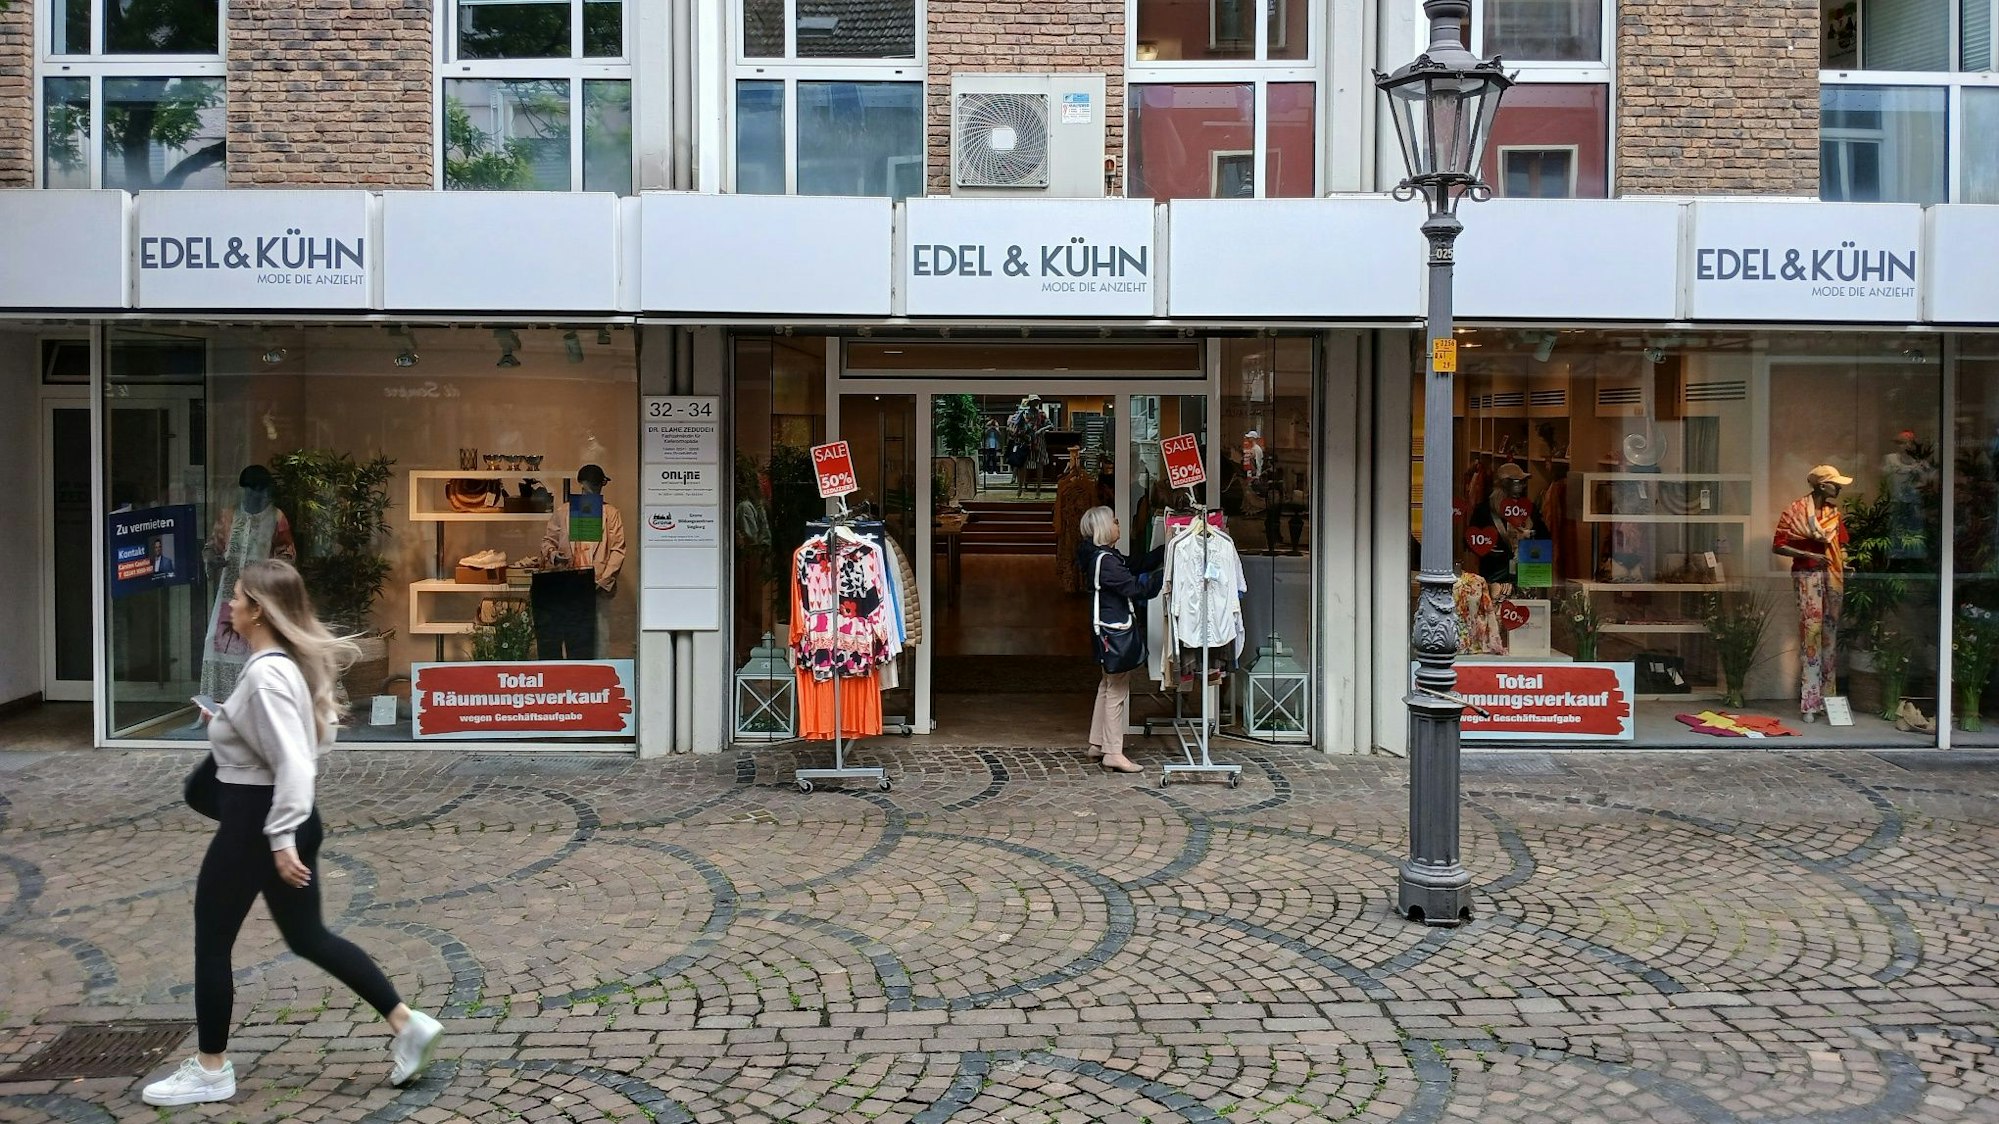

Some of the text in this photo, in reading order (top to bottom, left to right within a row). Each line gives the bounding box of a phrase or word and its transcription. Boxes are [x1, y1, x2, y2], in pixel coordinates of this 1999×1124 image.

[141, 228, 364, 270] EDEL & KÜHN
[913, 237, 1147, 277] EDEL & KÜHN
[1697, 241, 1915, 282] EDEL & KÜHN
[257, 274, 364, 285] MODE DIE ANZIEHT
[1041, 282, 1147, 293] MODE DIE ANZIEHT
[1812, 286, 1915, 298] MODE DIE ANZIEHT
[650, 402, 673, 417] 32
[688, 402, 712, 417] 34
[815, 444, 847, 463] SALE
[1165, 437, 1195, 455] SALE
[1171, 463, 1201, 480] 50%
[821, 472, 853, 489] 50%
[1504, 505, 1528, 517] 50%
[116, 518, 174, 536] Zu vermieten
[1471, 534, 1492, 545] 10%
[118, 546, 145, 560] Kontakt
[1503, 609, 1524, 623] 20%
[497, 672, 544, 689] Total
[1496, 673, 1543, 689] Total
[432, 689, 610, 709] Räumungsverkauf
[1461, 691, 1609, 709] mungsverkauf
[459, 712, 583, 723] wegen Geschäftsaufgabe
[1493, 713, 1581, 723] Geschäftsaufgabe
